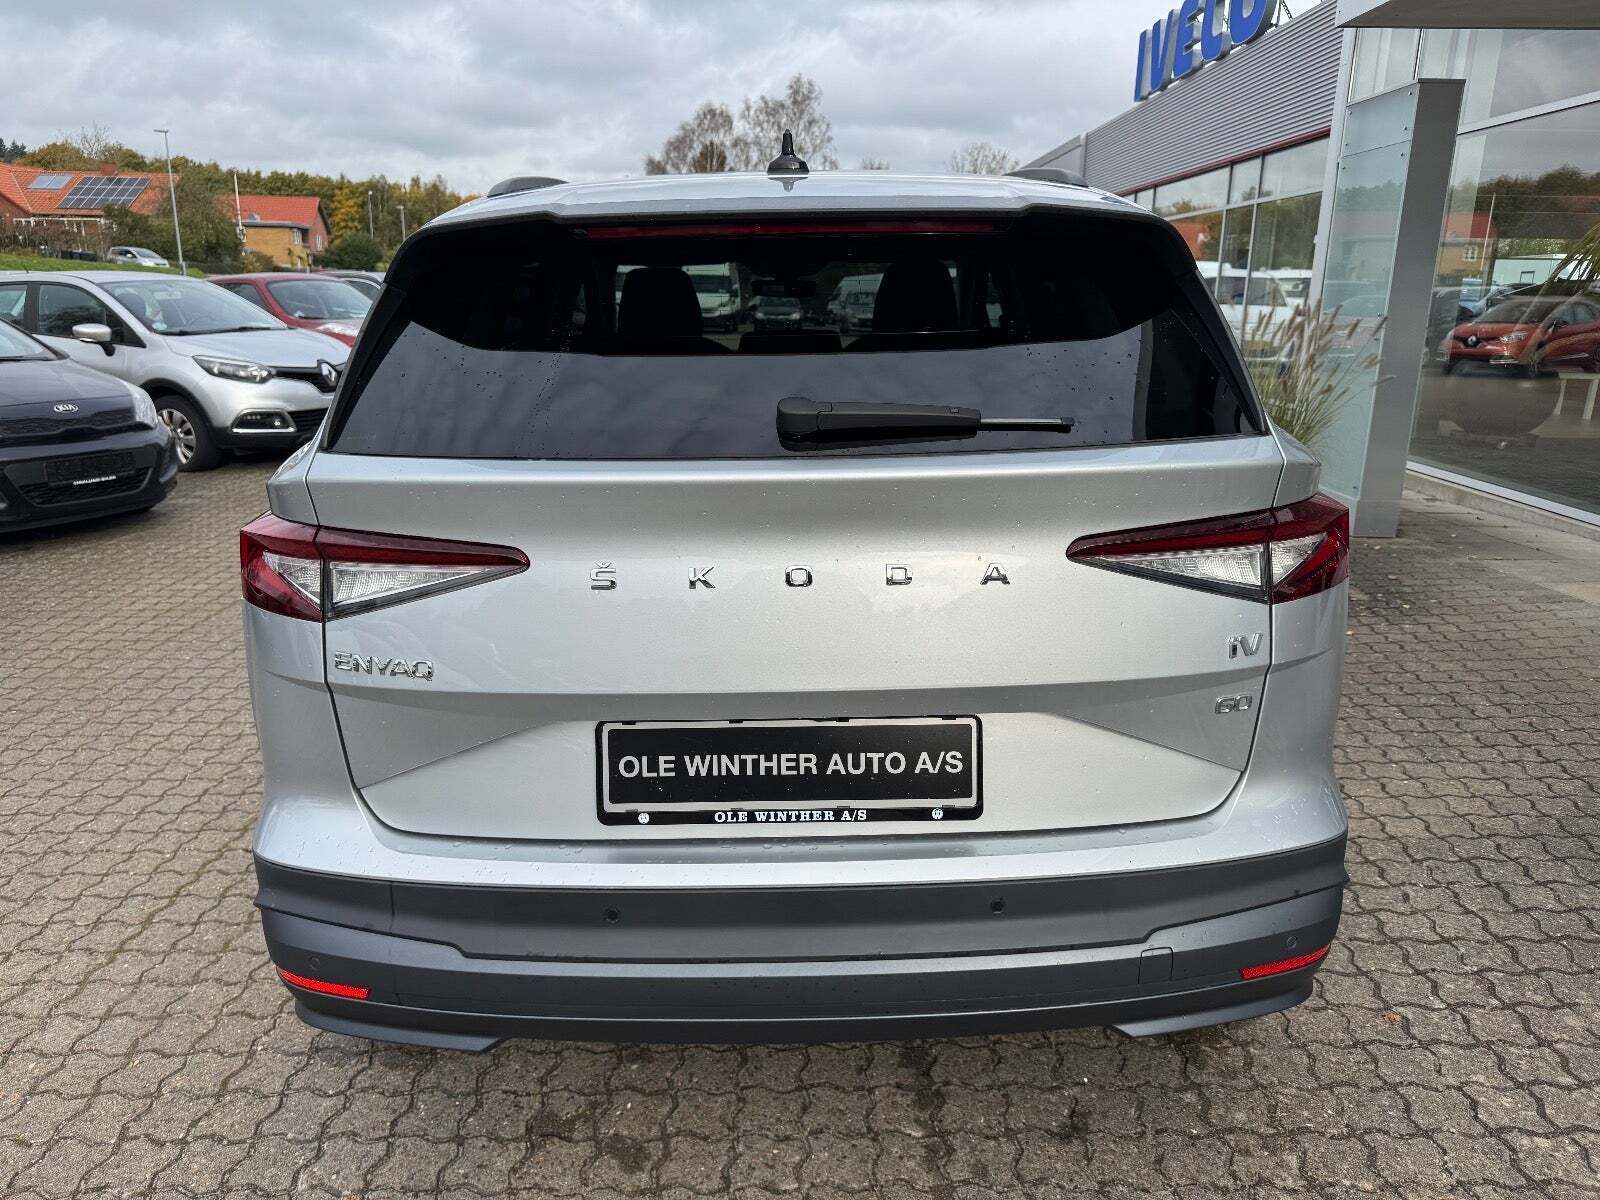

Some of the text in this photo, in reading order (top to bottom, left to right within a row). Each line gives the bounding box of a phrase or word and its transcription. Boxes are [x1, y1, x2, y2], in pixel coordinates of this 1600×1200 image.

[590, 561, 1010, 590] ŠKODA
[334, 651, 434, 681] ENYAQ
[1215, 695, 1252, 714] 60
[618, 750, 964, 778] OLE WINTHER AUTO A/S
[714, 809, 867, 823] OLE WINTHER A/S
